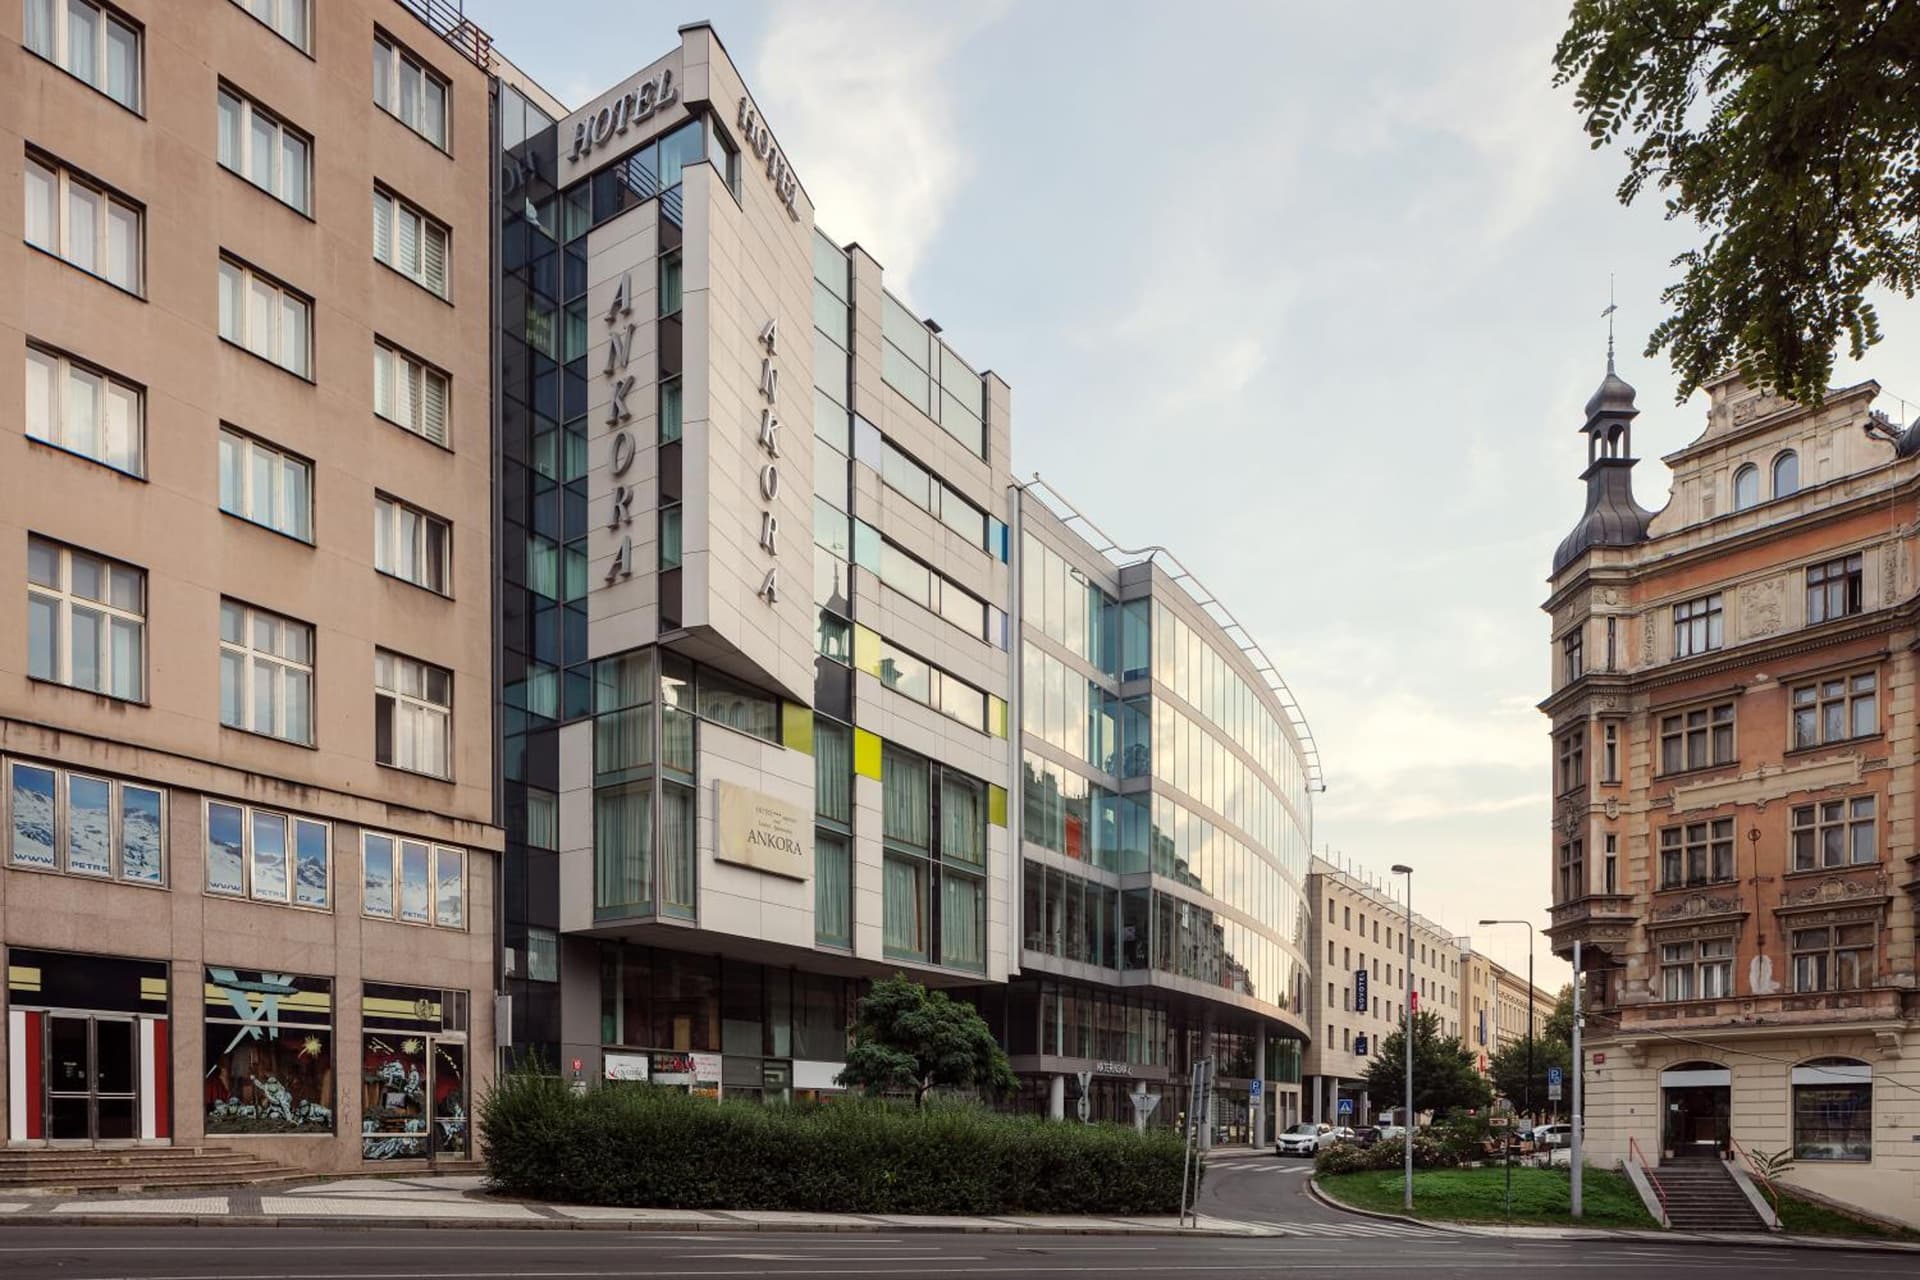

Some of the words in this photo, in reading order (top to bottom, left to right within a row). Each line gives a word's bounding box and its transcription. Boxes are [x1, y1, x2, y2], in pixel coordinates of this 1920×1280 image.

[567, 68, 678, 164] HOTEL
[736, 96, 801, 223] HOTEL
[604, 270, 636, 584] ANKORA
[758, 317, 783, 605] ANKORA
[747, 828, 802, 856] ANKORA
[1551, 1069, 1558, 1079] P
